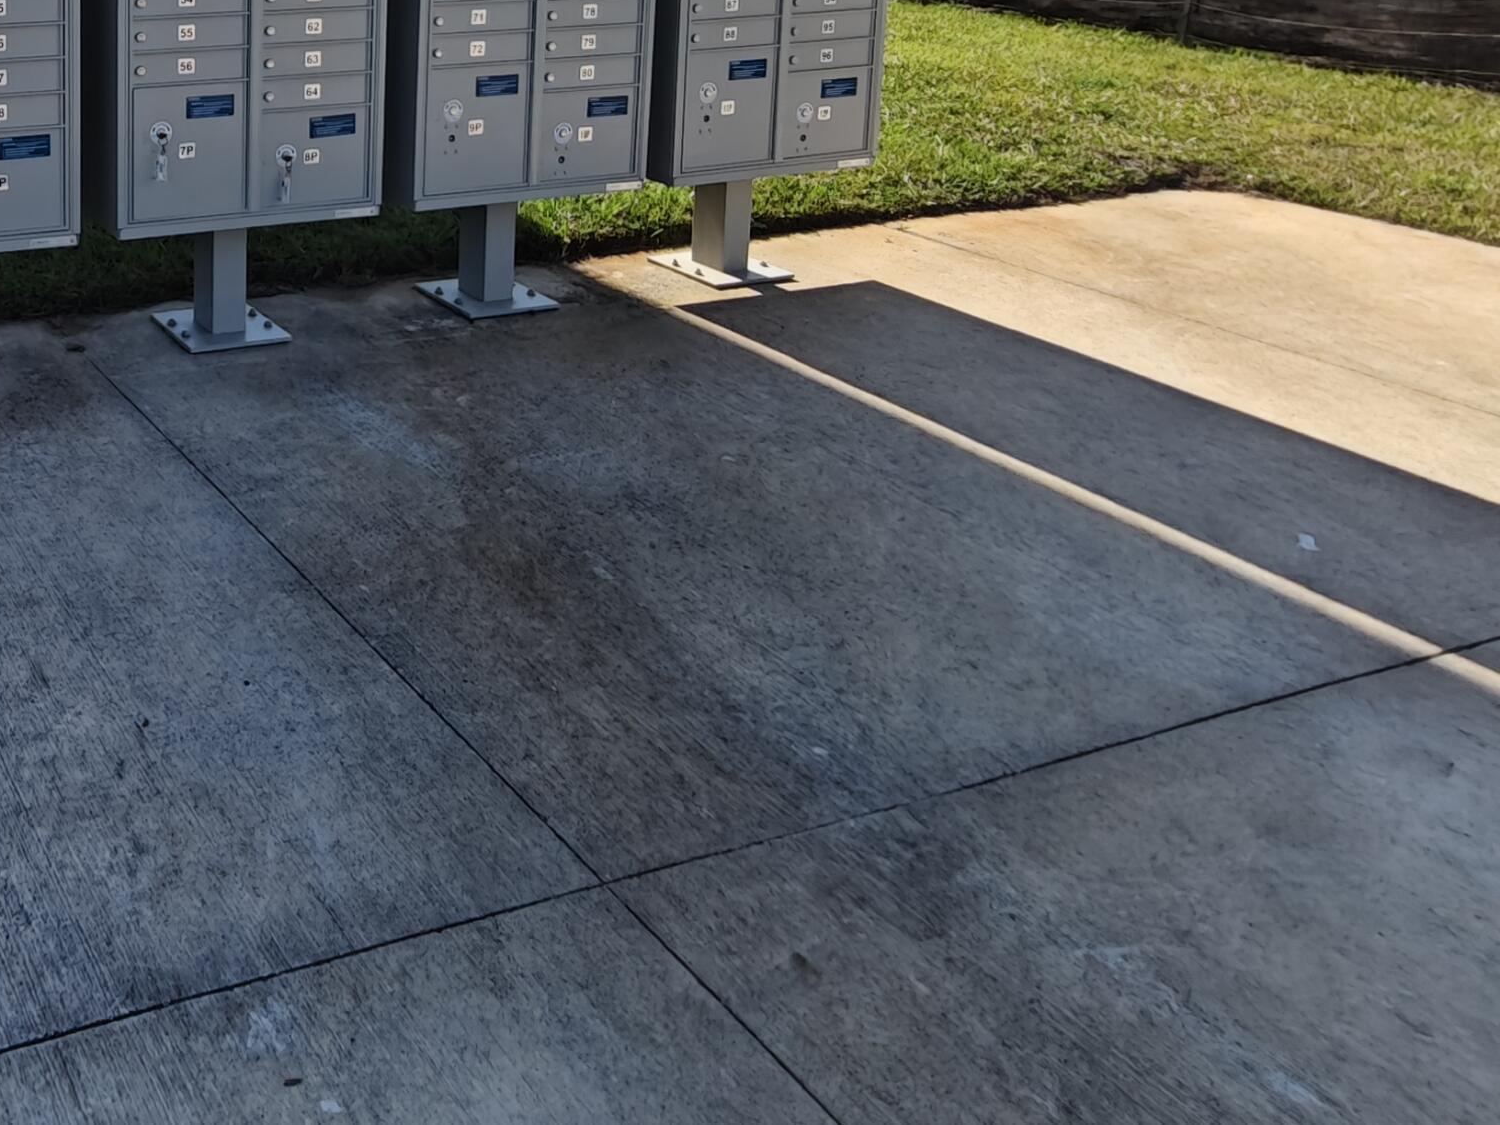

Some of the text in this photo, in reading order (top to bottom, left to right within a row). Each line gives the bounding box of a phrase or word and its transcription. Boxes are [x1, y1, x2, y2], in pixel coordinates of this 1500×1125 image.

[473, 12, 484, 22] 71
[585, 7, 596, 17] 78
[307, 21, 320, 32] 62
[180, 27, 194, 39] 55
[584, 37, 595, 47] 79
[472, 44, 484, 54] 72
[306, 54, 319, 65] 63
[180, 61, 193, 72] 56
[305, 87, 318, 97] 64
[469, 122, 482, 133] 9P
[180, 145, 194, 156] 7P
[304, 151, 318, 162] 8P
